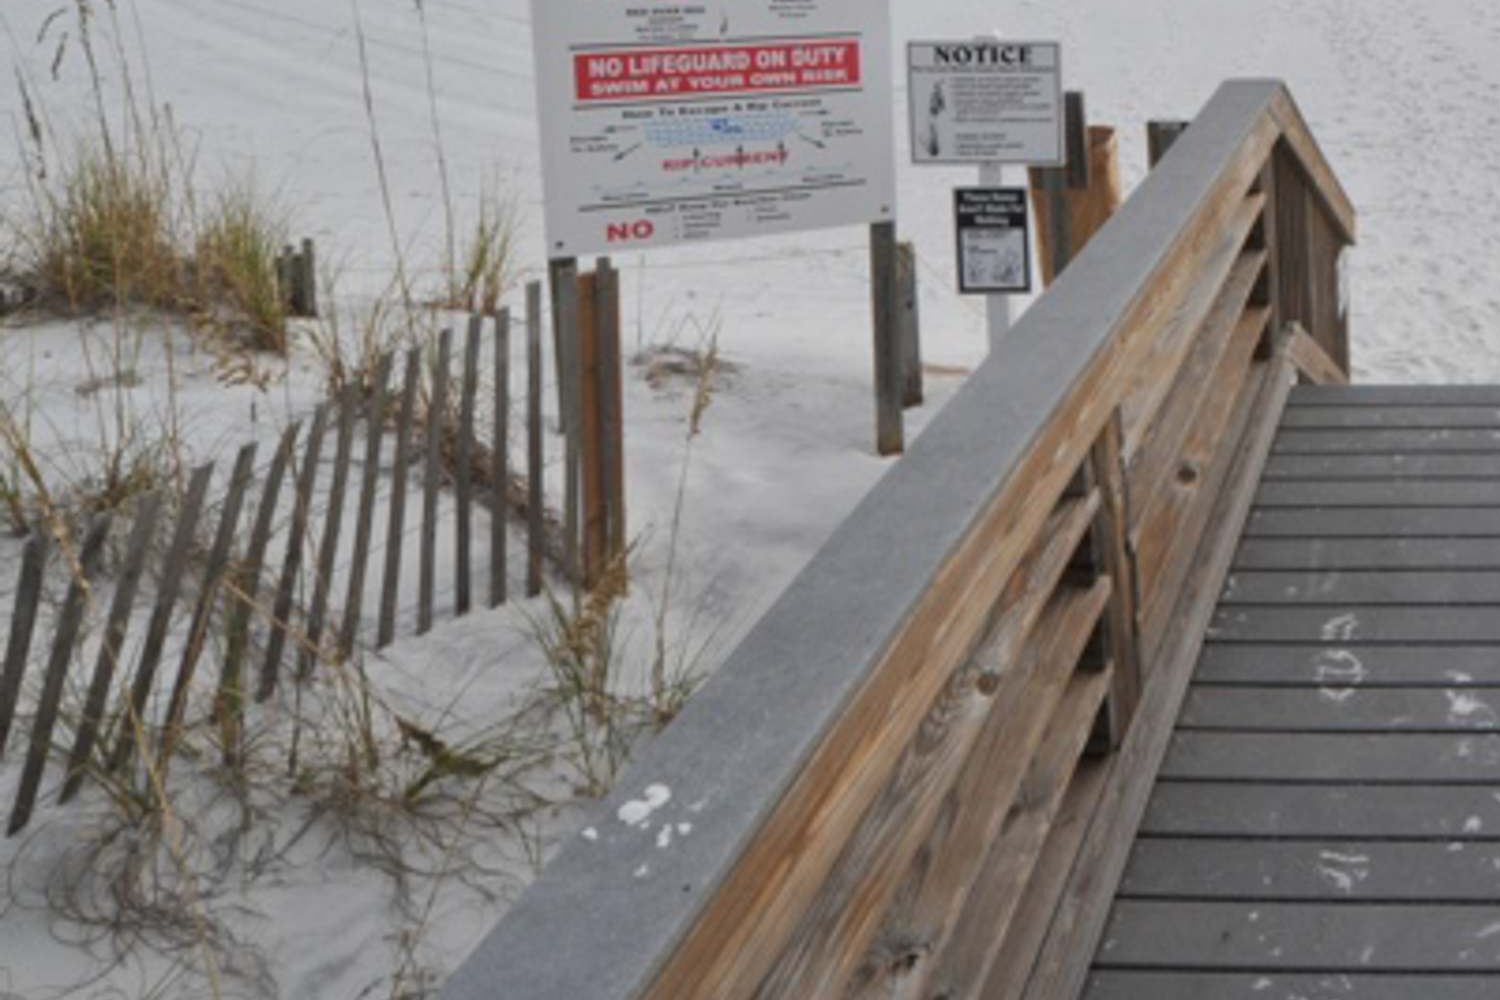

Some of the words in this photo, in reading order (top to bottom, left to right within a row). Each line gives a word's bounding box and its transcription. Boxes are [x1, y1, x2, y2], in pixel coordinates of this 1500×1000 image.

[588, 57, 623, 78] NO
[628, 50, 751, 75] LIFEGUARD
[755, 49, 788, 69] ON
[791, 47, 846, 67] DUTY
[933, 45, 1031, 64] NOTICE
[590, 80, 648, 96] SWIM
[655, 78, 680, 93] AT
[689, 74, 743, 91] YOUR
[750, 71, 796, 86] OWN
[802, 67, 849, 83] RISK
[659, 106, 675, 117] To
[679, 105, 729, 117] Escape
[660, 157, 693, 171] RIP
[699, 149, 789, 168] CURRENT
[606, 219, 654, 242] NO
